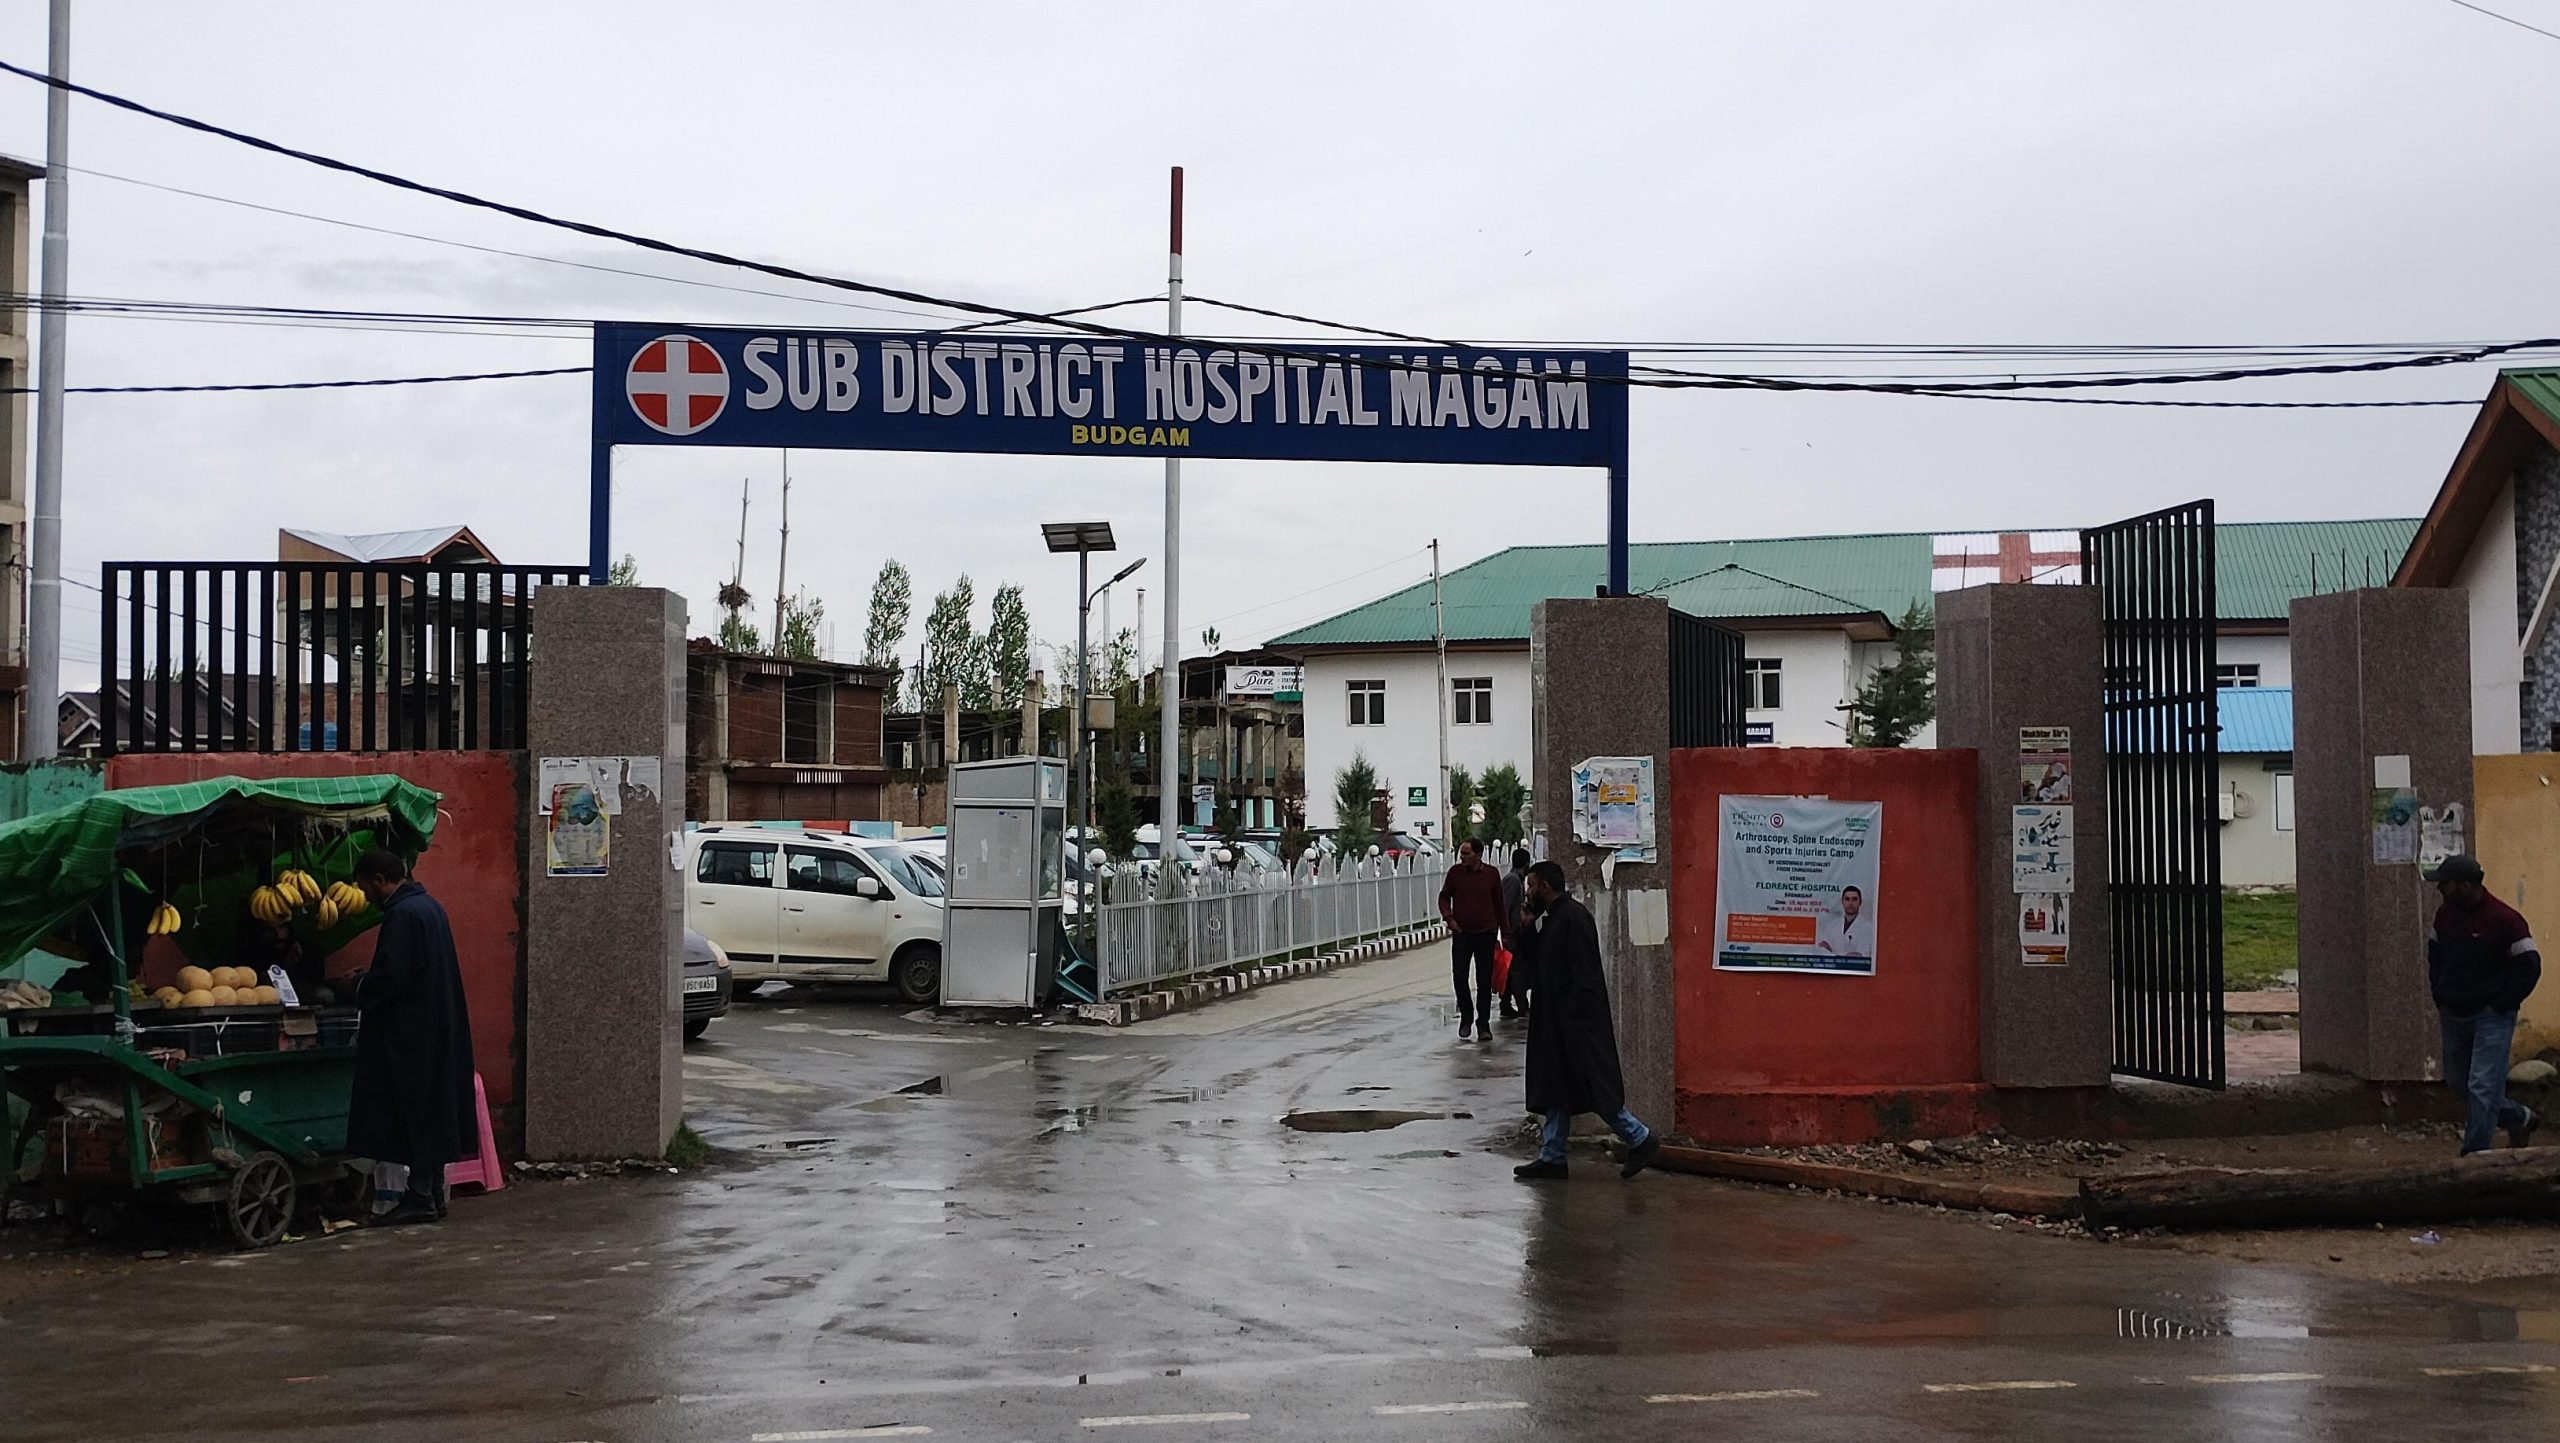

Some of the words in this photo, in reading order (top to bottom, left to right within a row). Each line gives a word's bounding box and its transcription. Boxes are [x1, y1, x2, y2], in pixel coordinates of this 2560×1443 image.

[743, 337, 860, 412] SUB
[881, 340, 1124, 418] DISTRICT
[1145, 348, 1378, 425] HOSPITAL
[1390, 355, 1589, 430] MAGAM
[1072, 425, 1189, 446] BUDGAM
[1792, 834, 1817, 845] Spine
[1819, 835, 1865, 848] Endoscopy
[1746, 845, 1762, 854] and
[1764, 845, 1793, 857] Sports
[1795, 848, 1828, 859] Injuries
[1830, 848, 1855, 859] Camp
[1756, 882, 1799, 891] FLORENCE
[1801, 884, 1841, 892] HOSPITAL
